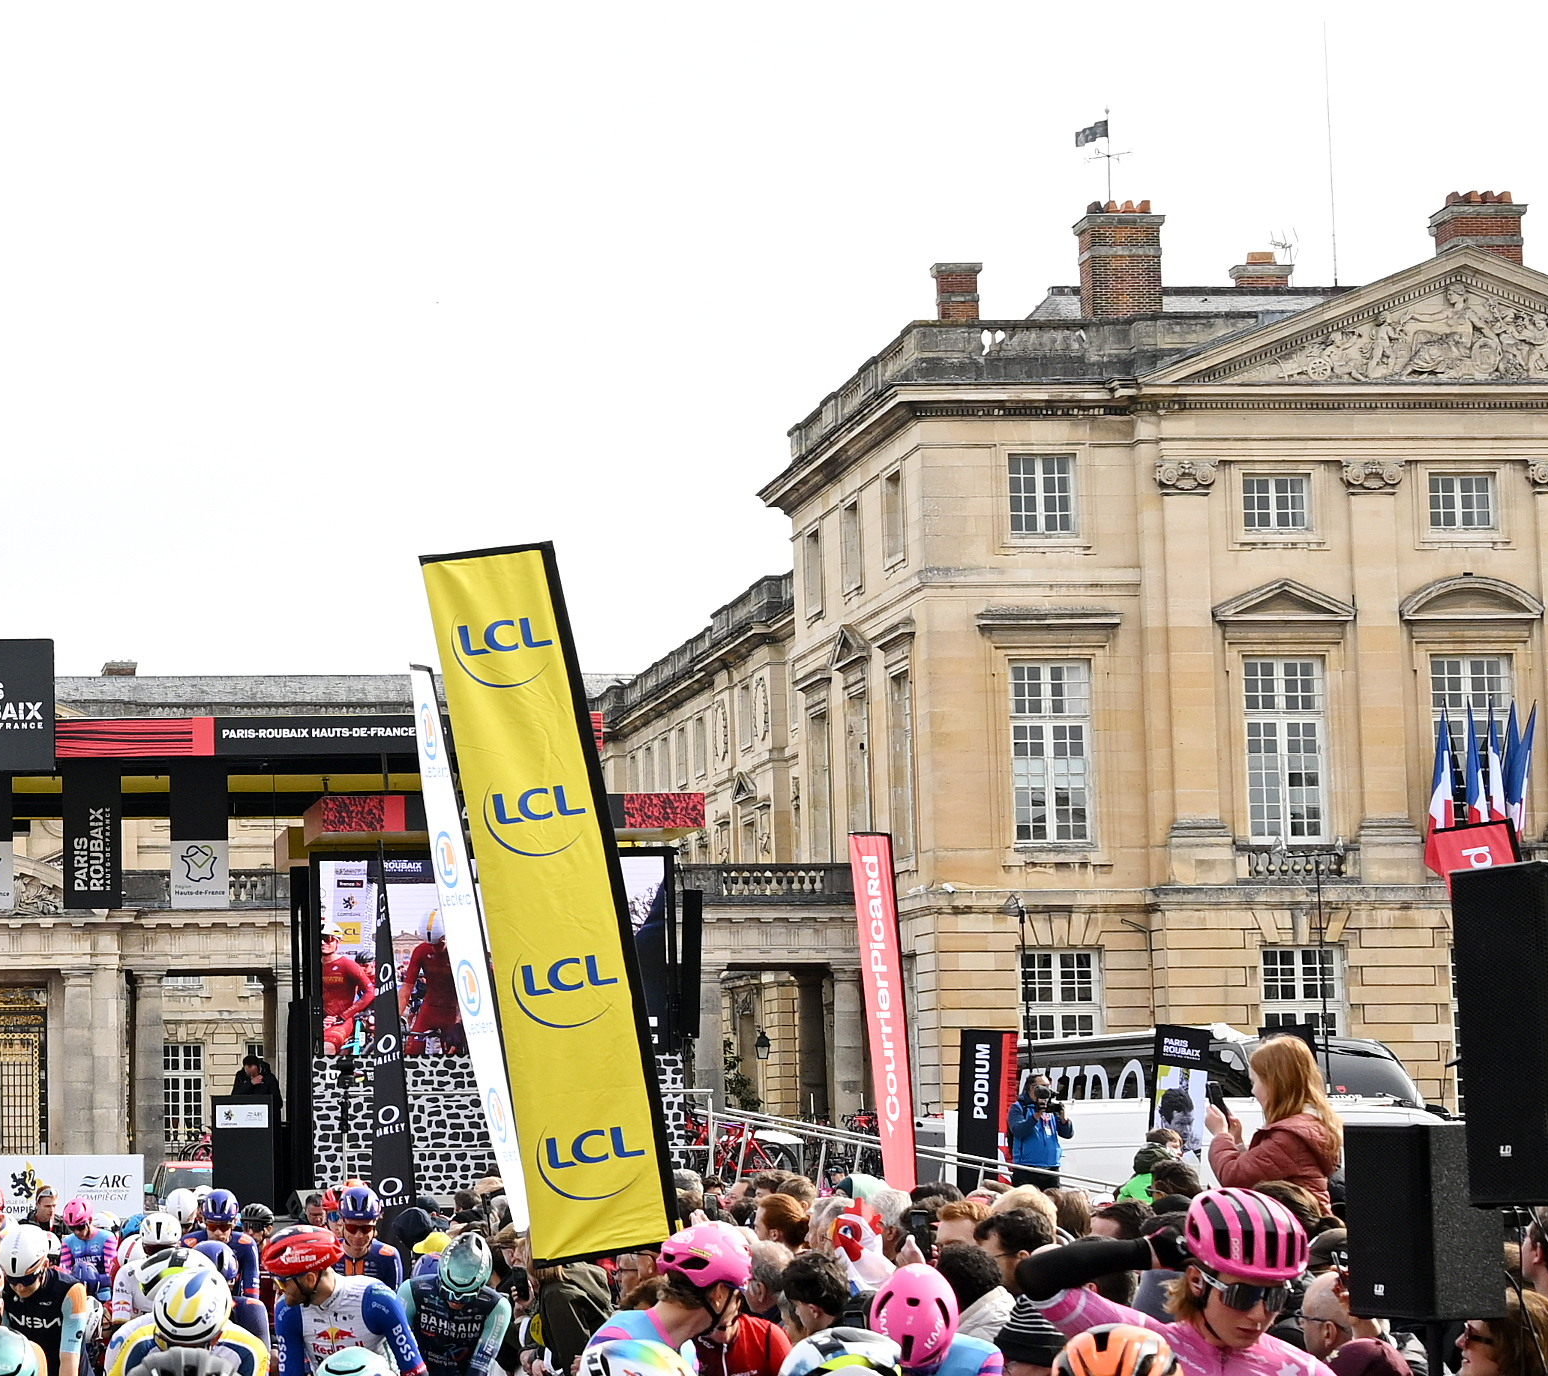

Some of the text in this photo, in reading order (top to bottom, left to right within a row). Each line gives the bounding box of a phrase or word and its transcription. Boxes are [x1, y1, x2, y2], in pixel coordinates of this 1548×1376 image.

[457, 617, 553, 659] LCL
[222, 725, 416, 739] PARIS-ROUBAIX HAUTS-DE-FRANCE
[492, 785, 586, 824] LCL
[73, 836, 89, 892] PARIS
[90, 806, 104, 891] ROUBAIX
[521, 954, 618, 997] LCL
[862, 855, 901, 1123] CourrierPicard
[1163, 1037, 1189, 1047] PARIS
[1163, 1045, 1201, 1058] ROUBAIX
[973, 1043, 991, 1120] PODIUM
[546, 1125, 645, 1168] LCL
[75, 1192, 129, 1202] COMPIÈGNE
[99, 1174, 134, 1189] ARC
[420, 1312, 481, 1333] BAHRAIN
[312, 1342, 335, 1356] Red
[392, 1324, 415, 1362] BOSS
